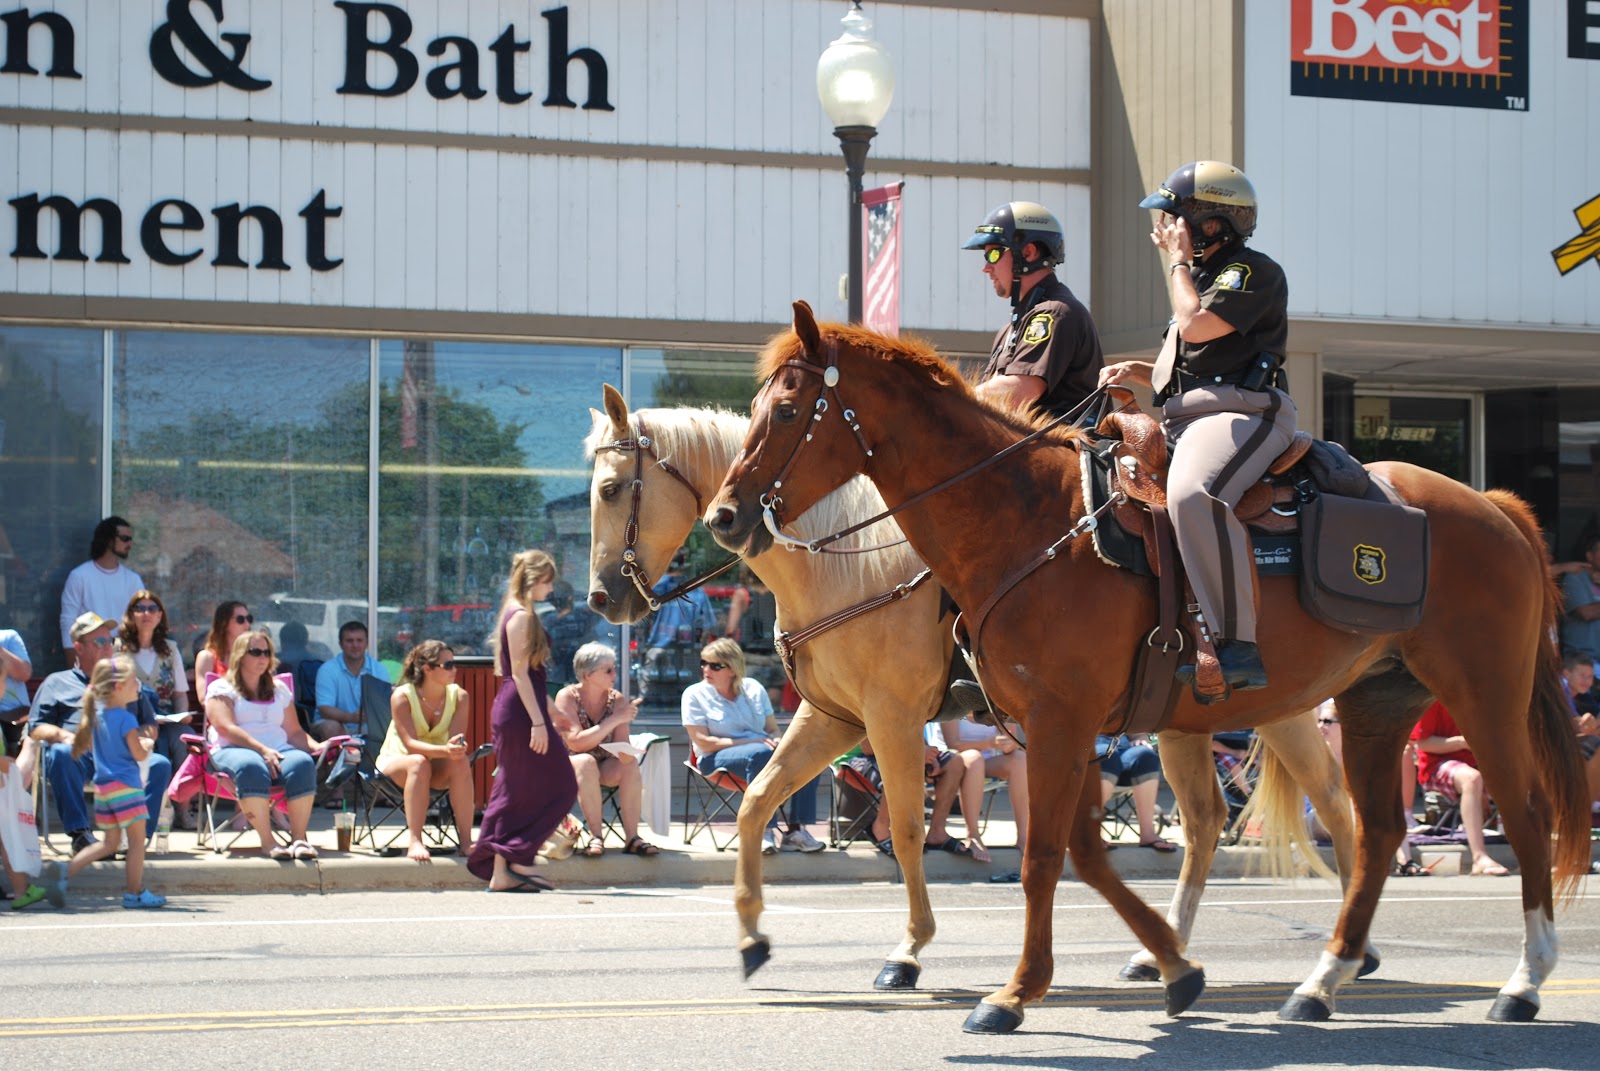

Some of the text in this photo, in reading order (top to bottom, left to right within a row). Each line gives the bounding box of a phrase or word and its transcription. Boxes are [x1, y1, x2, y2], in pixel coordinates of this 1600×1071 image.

[0, 0, 615, 112] n & Bath
[1303, 0, 1494, 70] Best
[1505, 96, 1526, 110] TM
[8, 188, 344, 272] ment
